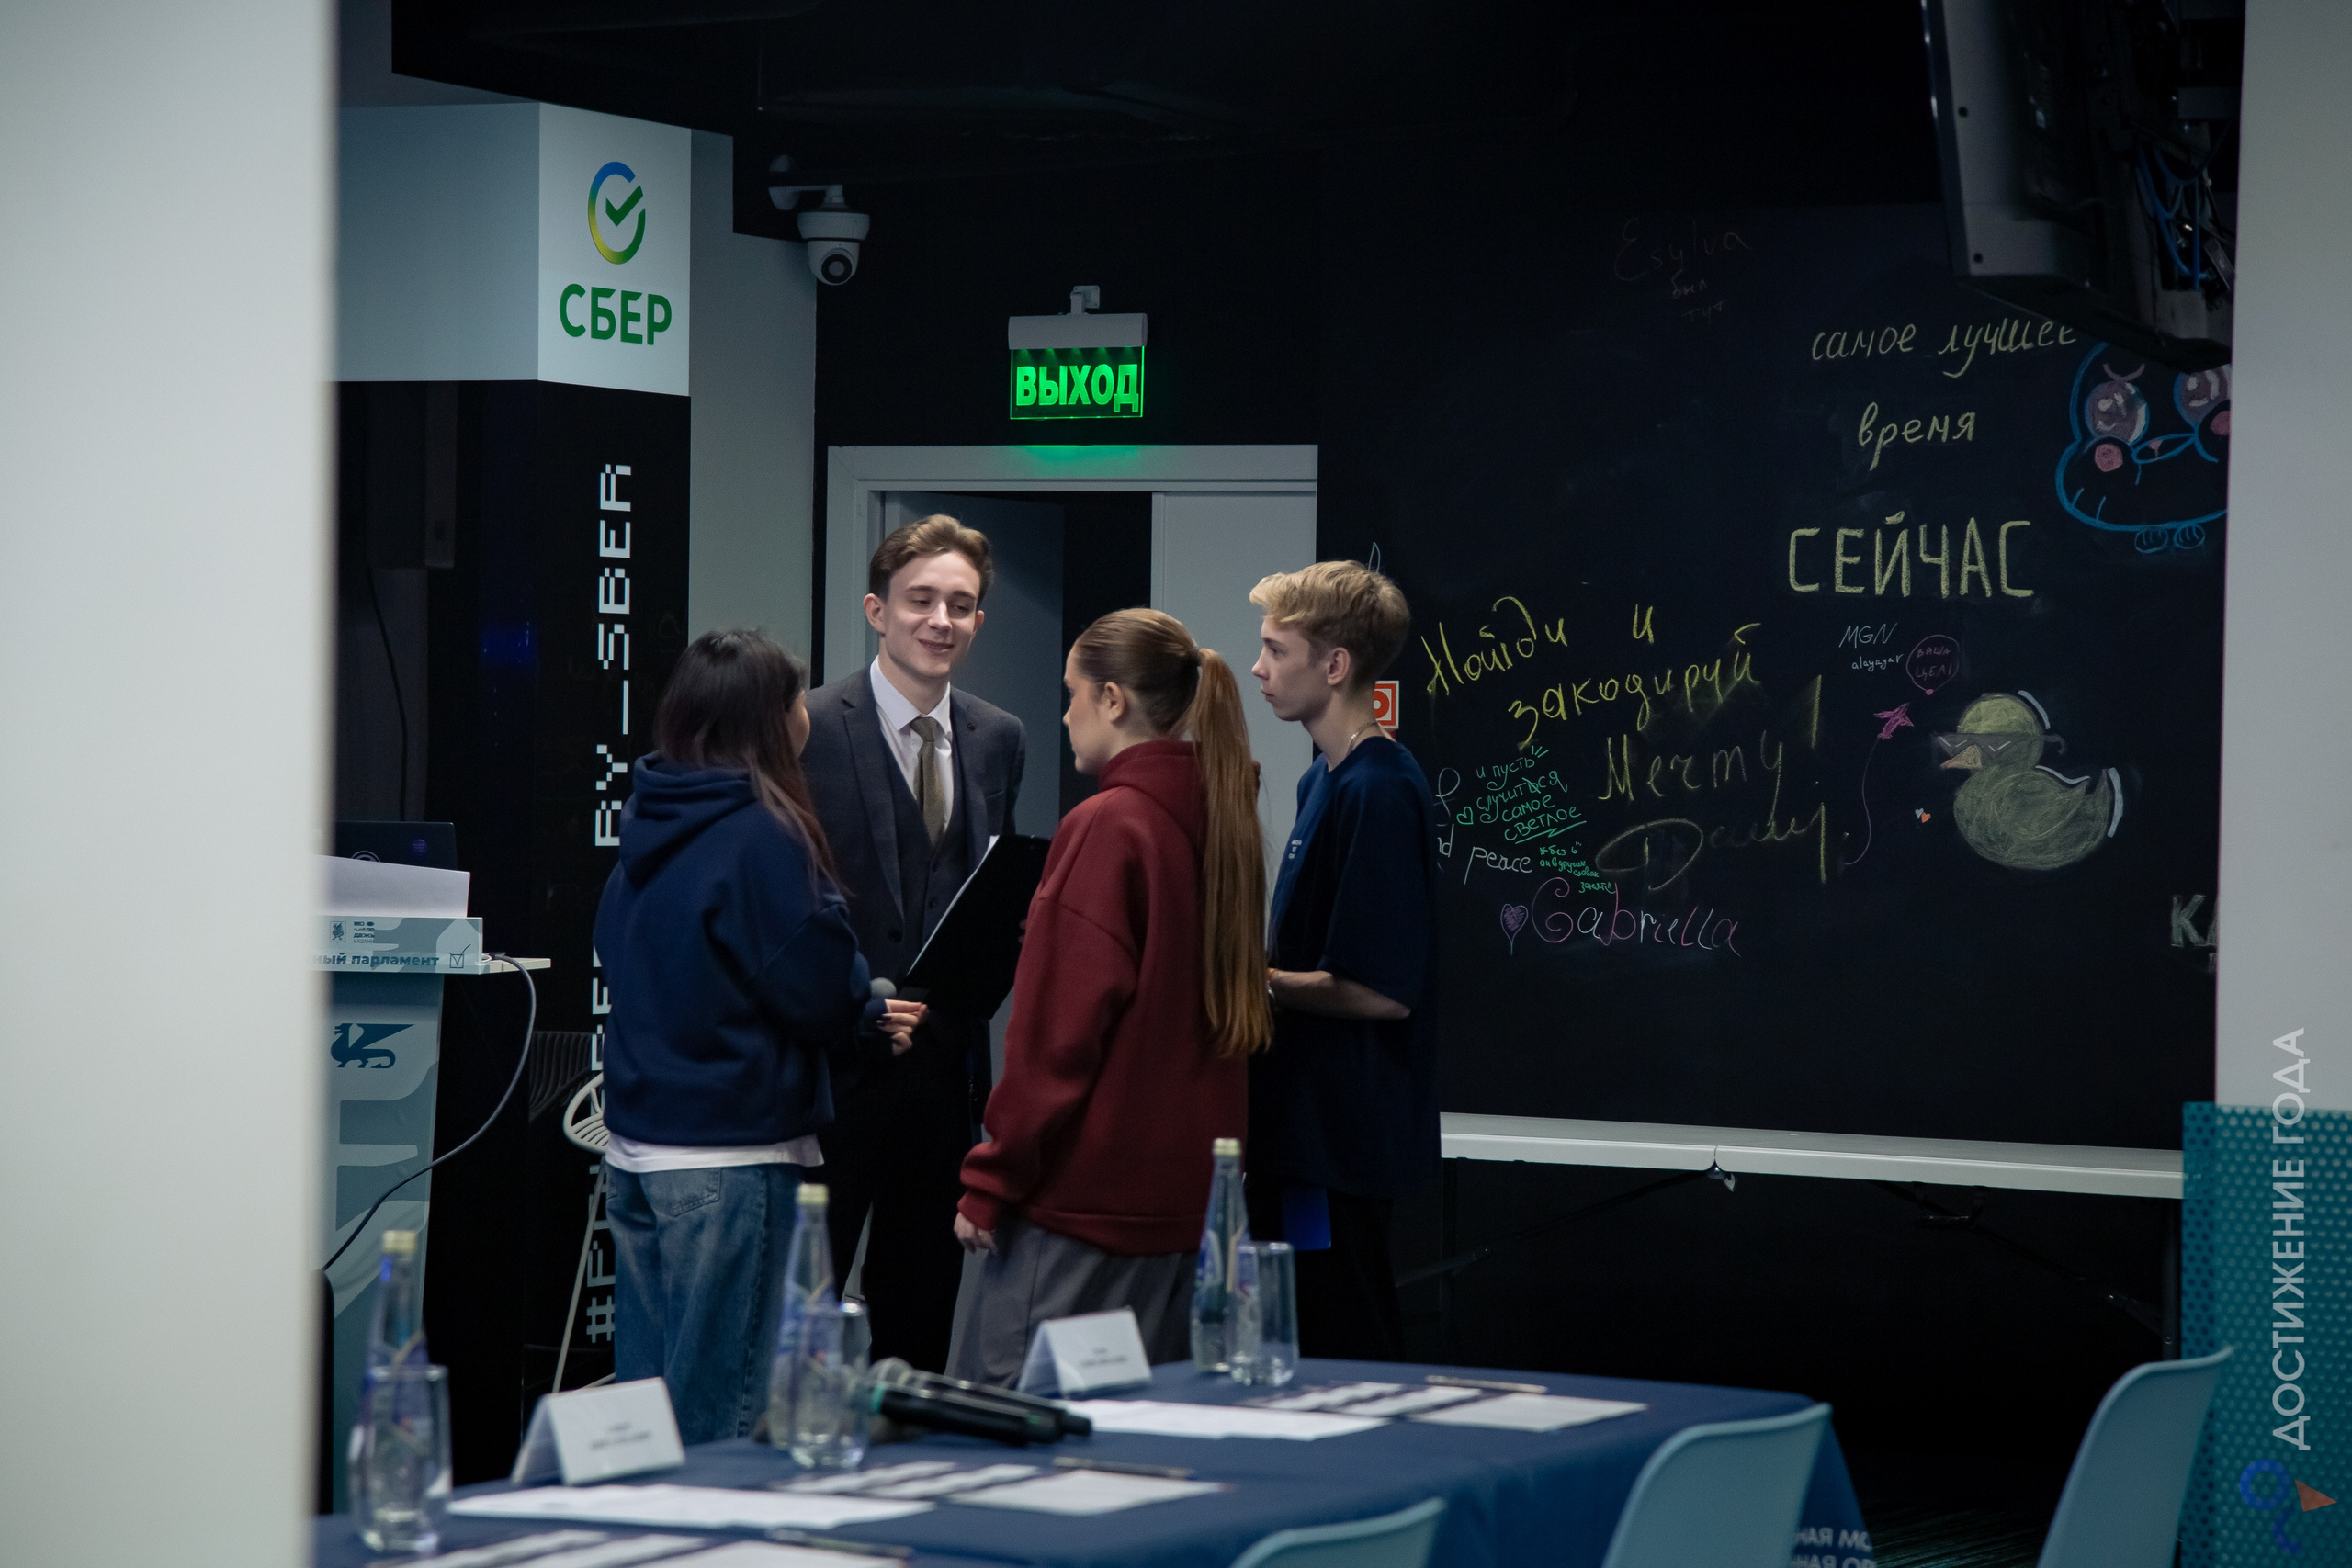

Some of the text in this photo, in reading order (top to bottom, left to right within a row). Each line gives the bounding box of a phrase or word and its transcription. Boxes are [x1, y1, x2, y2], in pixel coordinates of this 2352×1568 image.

[559, 283, 673, 346] СБЕР
[1811, 317, 2078, 378] самое лучшее
[1015, 363, 1139, 412] ВЫХОД
[1857, 400, 1976, 471] время
[1789, 510, 2034, 599] СЕЙЧАС
[1420, 596, 1655, 696] Найди и
[1838, 622, 1898, 649] MGN
[1508, 622, 1762, 750] закодируй
[1487, 757, 1535, 791] пусть
[1501, 795, 1555, 822] самое
[1504, 806, 1583, 841] светлое
[1464, 846, 1532, 886] peace
[1531, 876, 1743, 958] Gabriella
[351, 954, 439, 968] парламент
